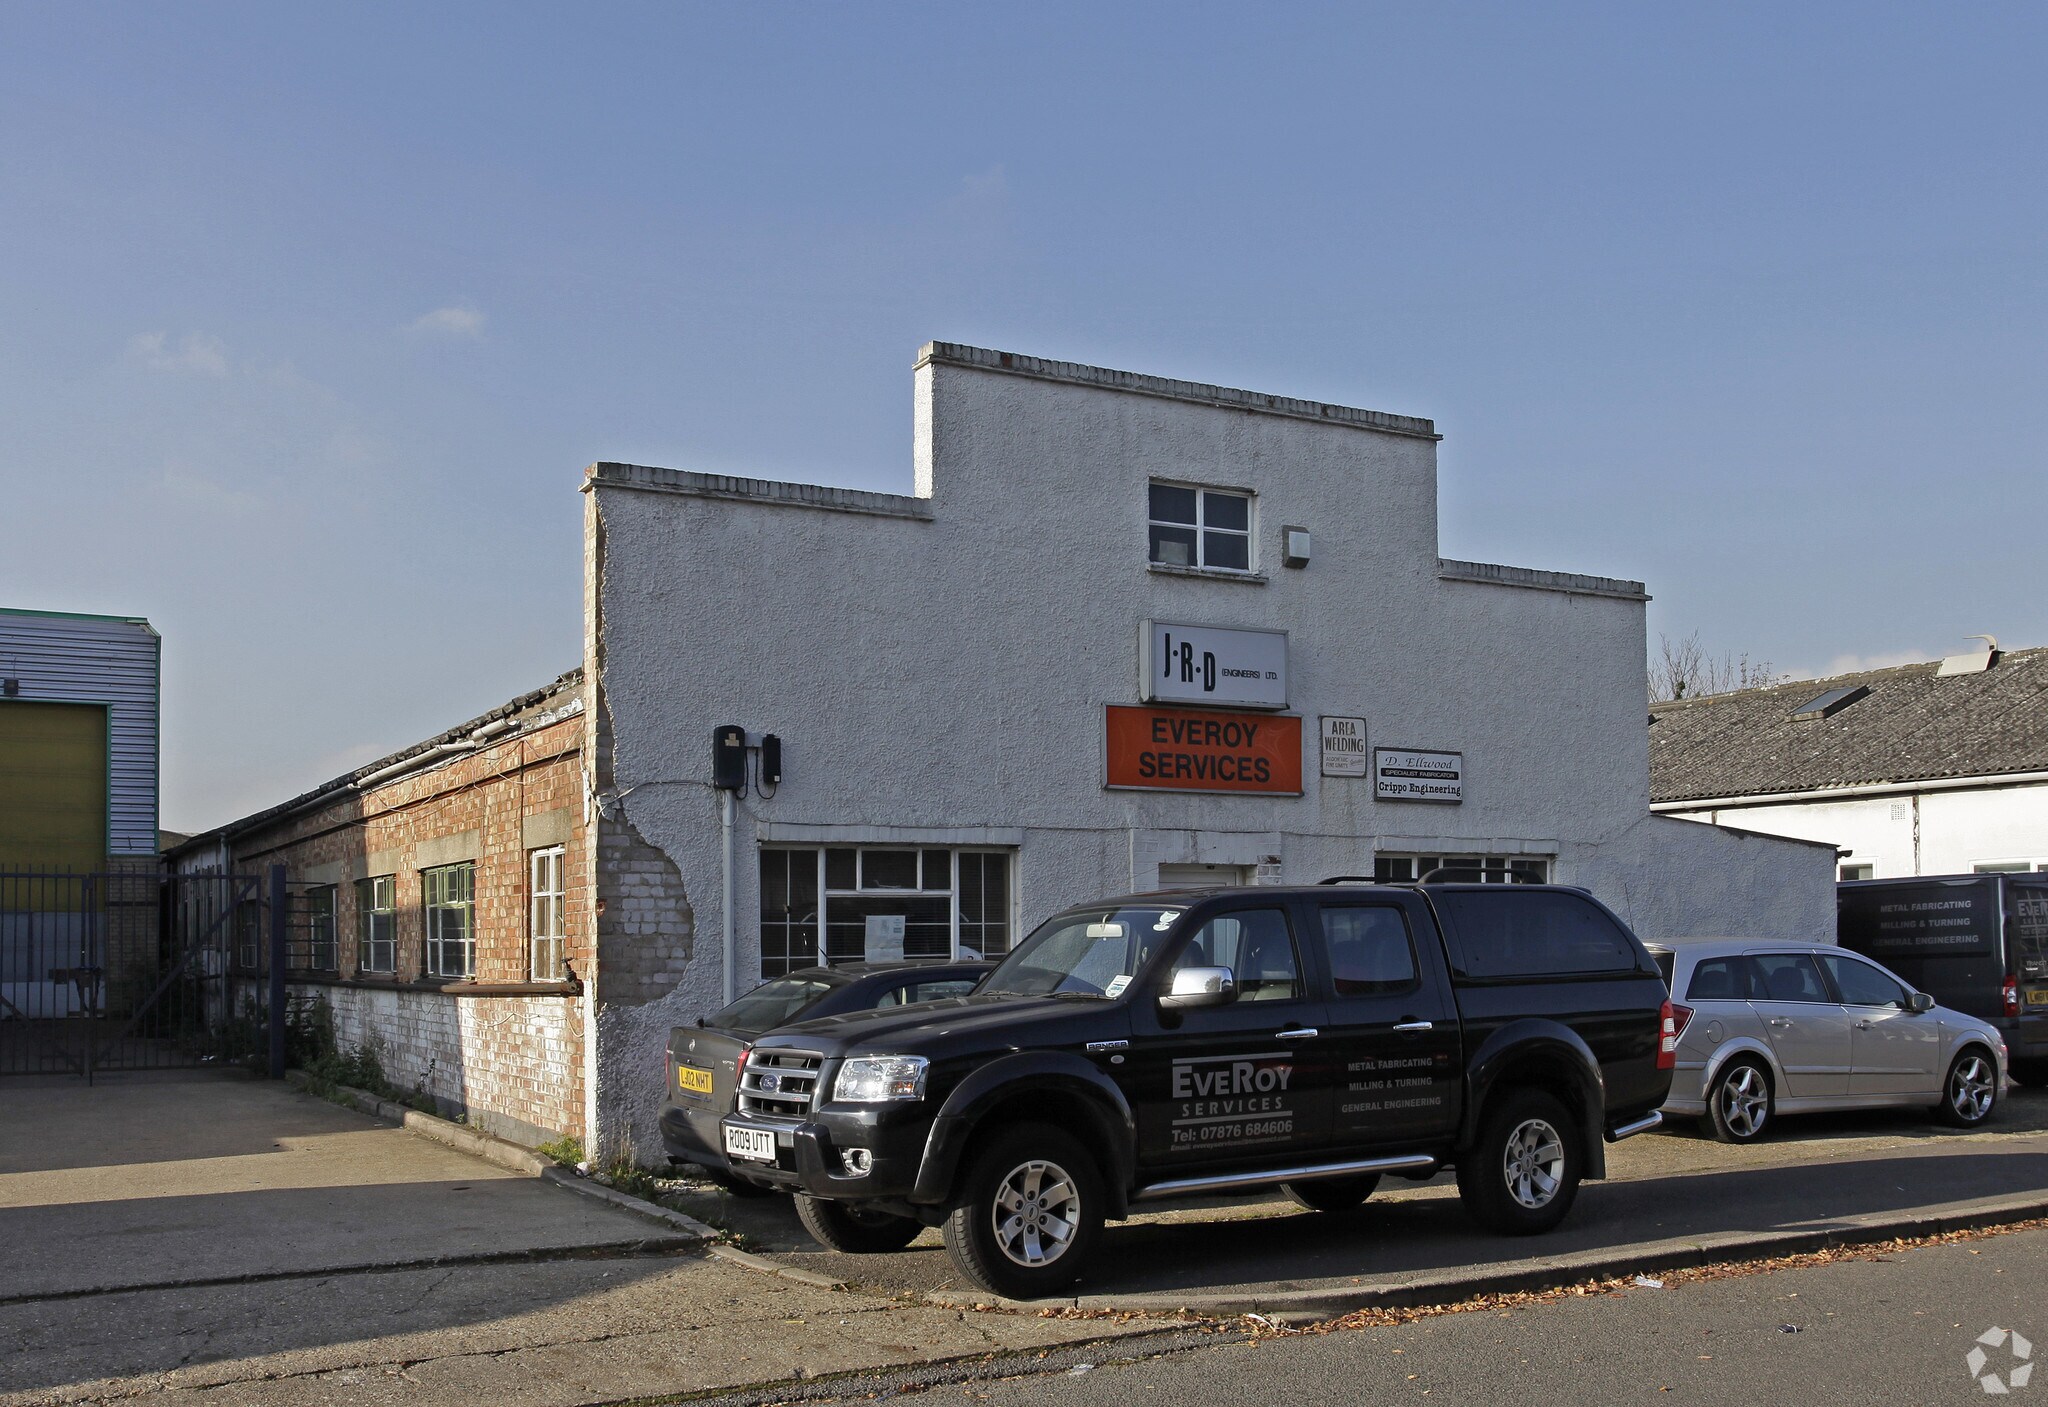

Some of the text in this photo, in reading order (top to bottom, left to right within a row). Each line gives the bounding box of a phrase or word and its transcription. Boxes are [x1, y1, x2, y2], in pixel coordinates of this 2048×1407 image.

[1222, 668, 1260, 679] (ENGINEERS)
[1152, 718, 1258, 748] EVEROY
[1332, 721, 1356, 736] AREA
[1325, 737, 1364, 752] WELDING
[1139, 752, 1270, 783] SERVICES
[1385, 756, 1454, 769] D. Ellwood
[1385, 769, 1455, 779] SPECIALIST FABRICATOR
[1379, 781, 1461, 796] Crippo Engineering
[1880, 900, 1971, 913] METAL FABRICATING
[1880, 917, 1971, 929] MILLING & TURNING
[1873, 934, 1979, 947] GENERAL ENGINEERING
[1088, 1040, 1129, 1050] RANGER
[1348, 1057, 1433, 1072] METAL FABRICATING
[681, 1067, 709, 1089] LJ02 NHT
[1349, 1077, 1433, 1091] MILLING & TURNING
[1182, 1096, 1282, 1118] SERVICES
[1342, 1097, 1441, 1113] GENERAL ENGINEERING
[1172, 1120, 1293, 1143] Tel: 07876 684606
[729, 1129, 770, 1153] RO09 UTT
